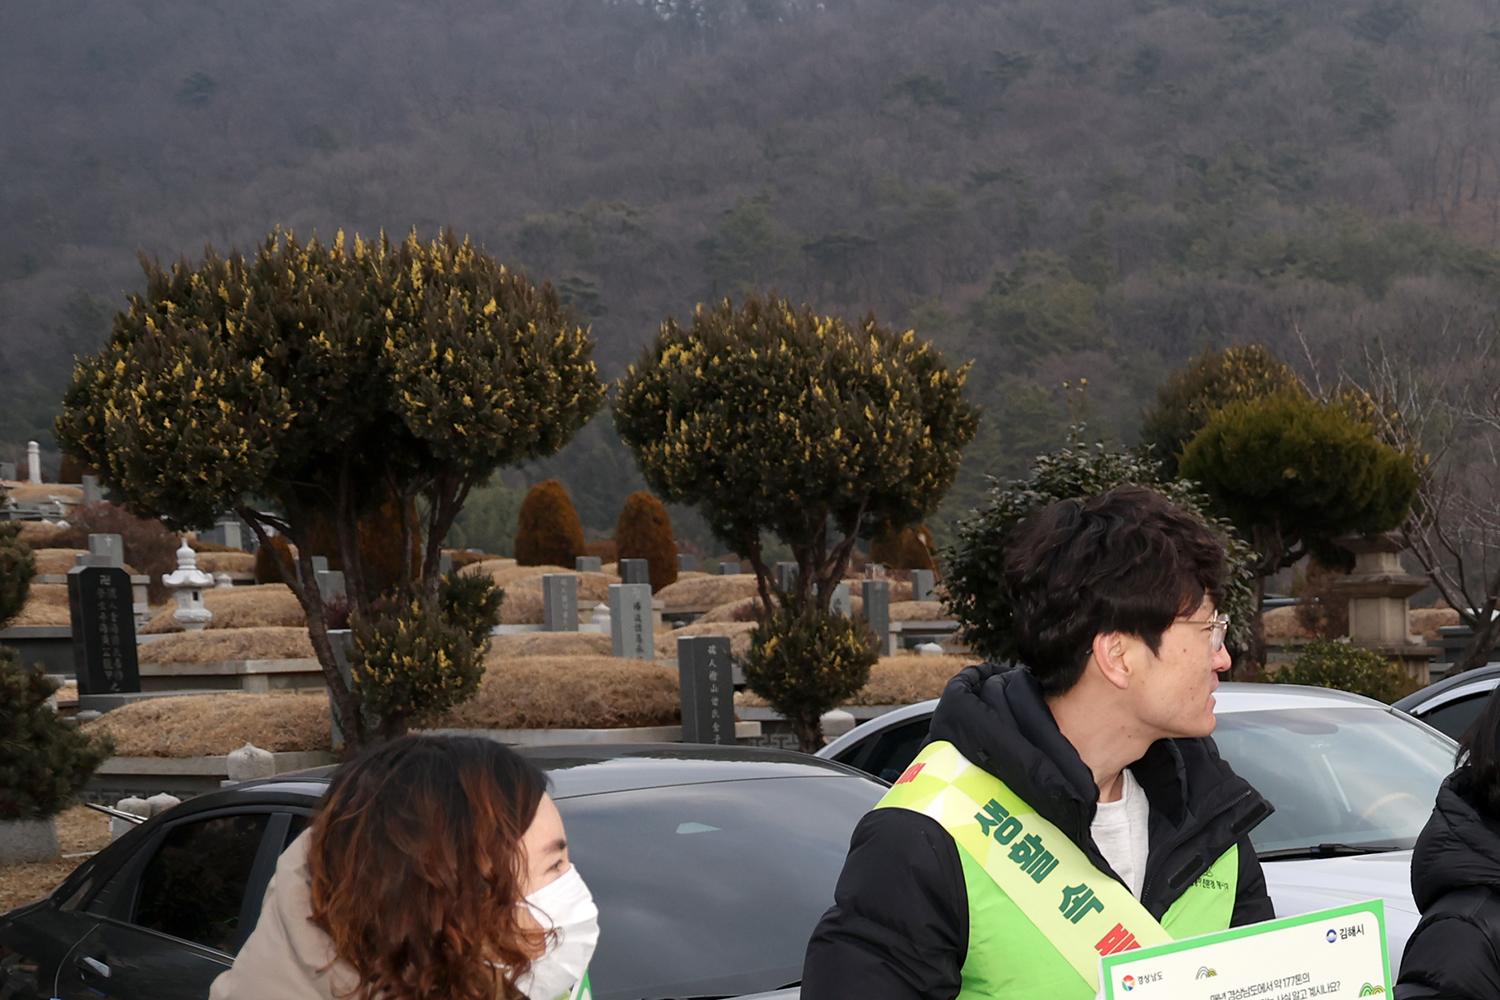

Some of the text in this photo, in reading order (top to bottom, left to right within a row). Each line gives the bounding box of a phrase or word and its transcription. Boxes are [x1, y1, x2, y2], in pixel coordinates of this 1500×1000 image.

[974, 797, 1104, 925] 생활 속
[1339, 924, 1365, 941] 김해시
[1137, 971, 1164, 986] 경상남도
[1273, 979, 1283, 990] 약
[1282, 972, 1310, 989] 177톤의
[1308, 981, 1341, 998] 계시나요?
